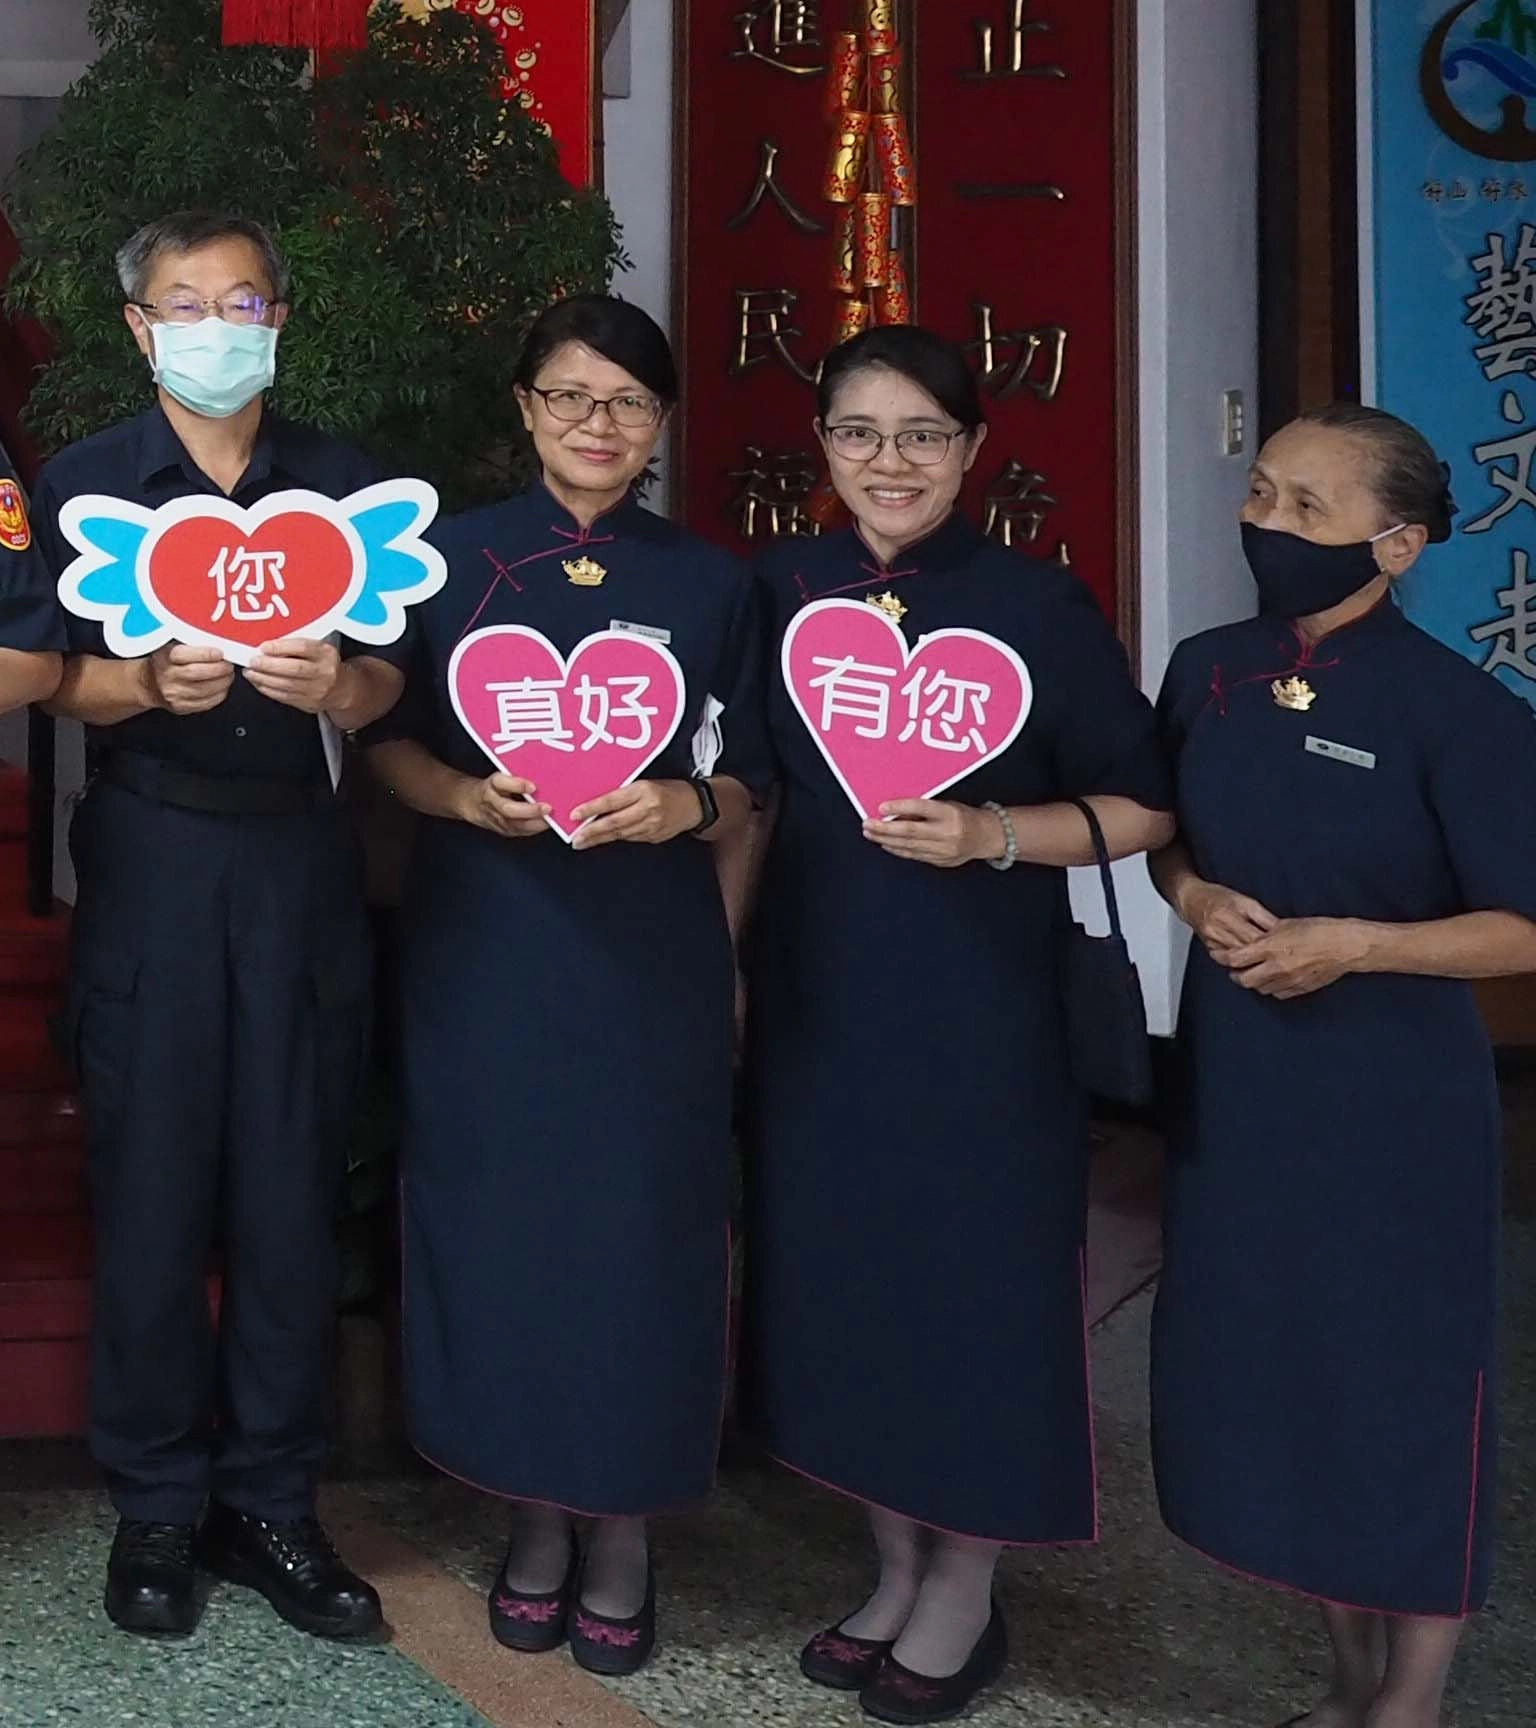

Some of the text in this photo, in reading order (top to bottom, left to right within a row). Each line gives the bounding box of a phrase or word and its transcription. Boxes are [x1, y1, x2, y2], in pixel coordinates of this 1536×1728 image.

[208, 545, 291, 623] 您
[484, 674, 659, 754] 真好
[808, 654, 991, 755] 有您
